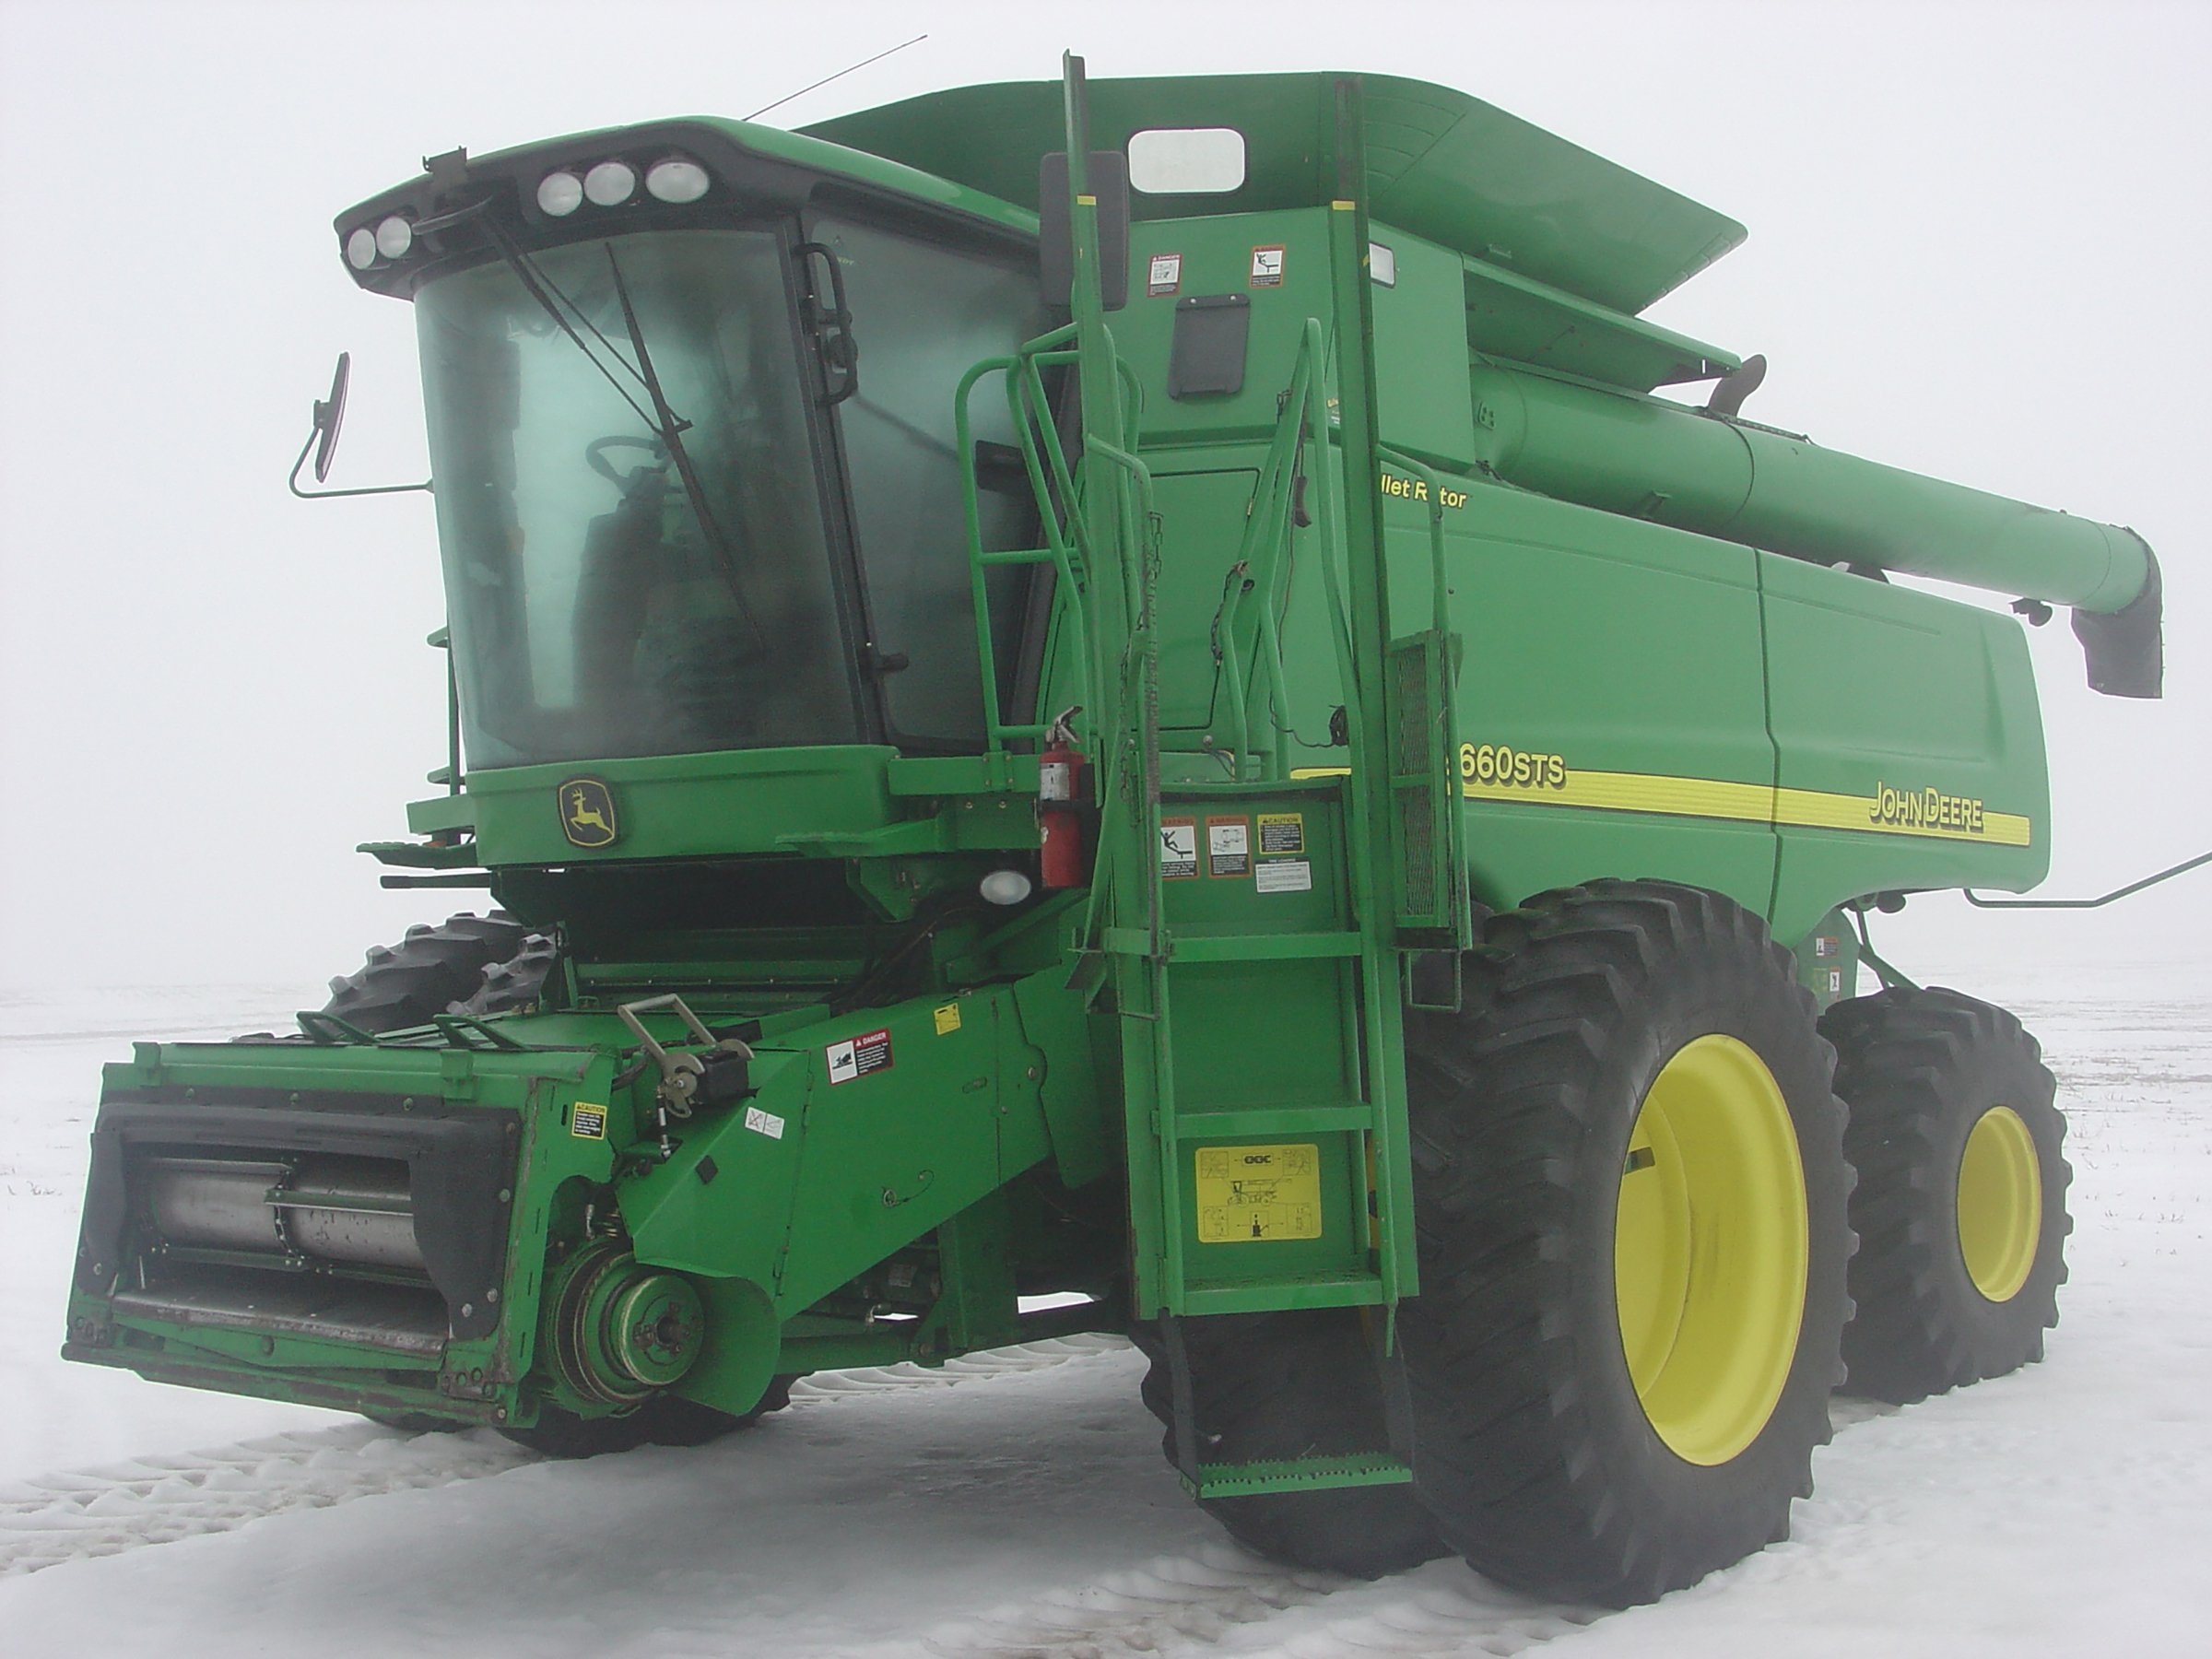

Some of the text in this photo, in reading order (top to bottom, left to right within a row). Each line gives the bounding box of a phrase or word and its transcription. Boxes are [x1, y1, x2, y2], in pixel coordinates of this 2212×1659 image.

[1414, 481, 1466, 508] Rtor
[1869, 780, 1983, 832] JOHN DEERE
[863, 1031, 887, 1044] DANGER
